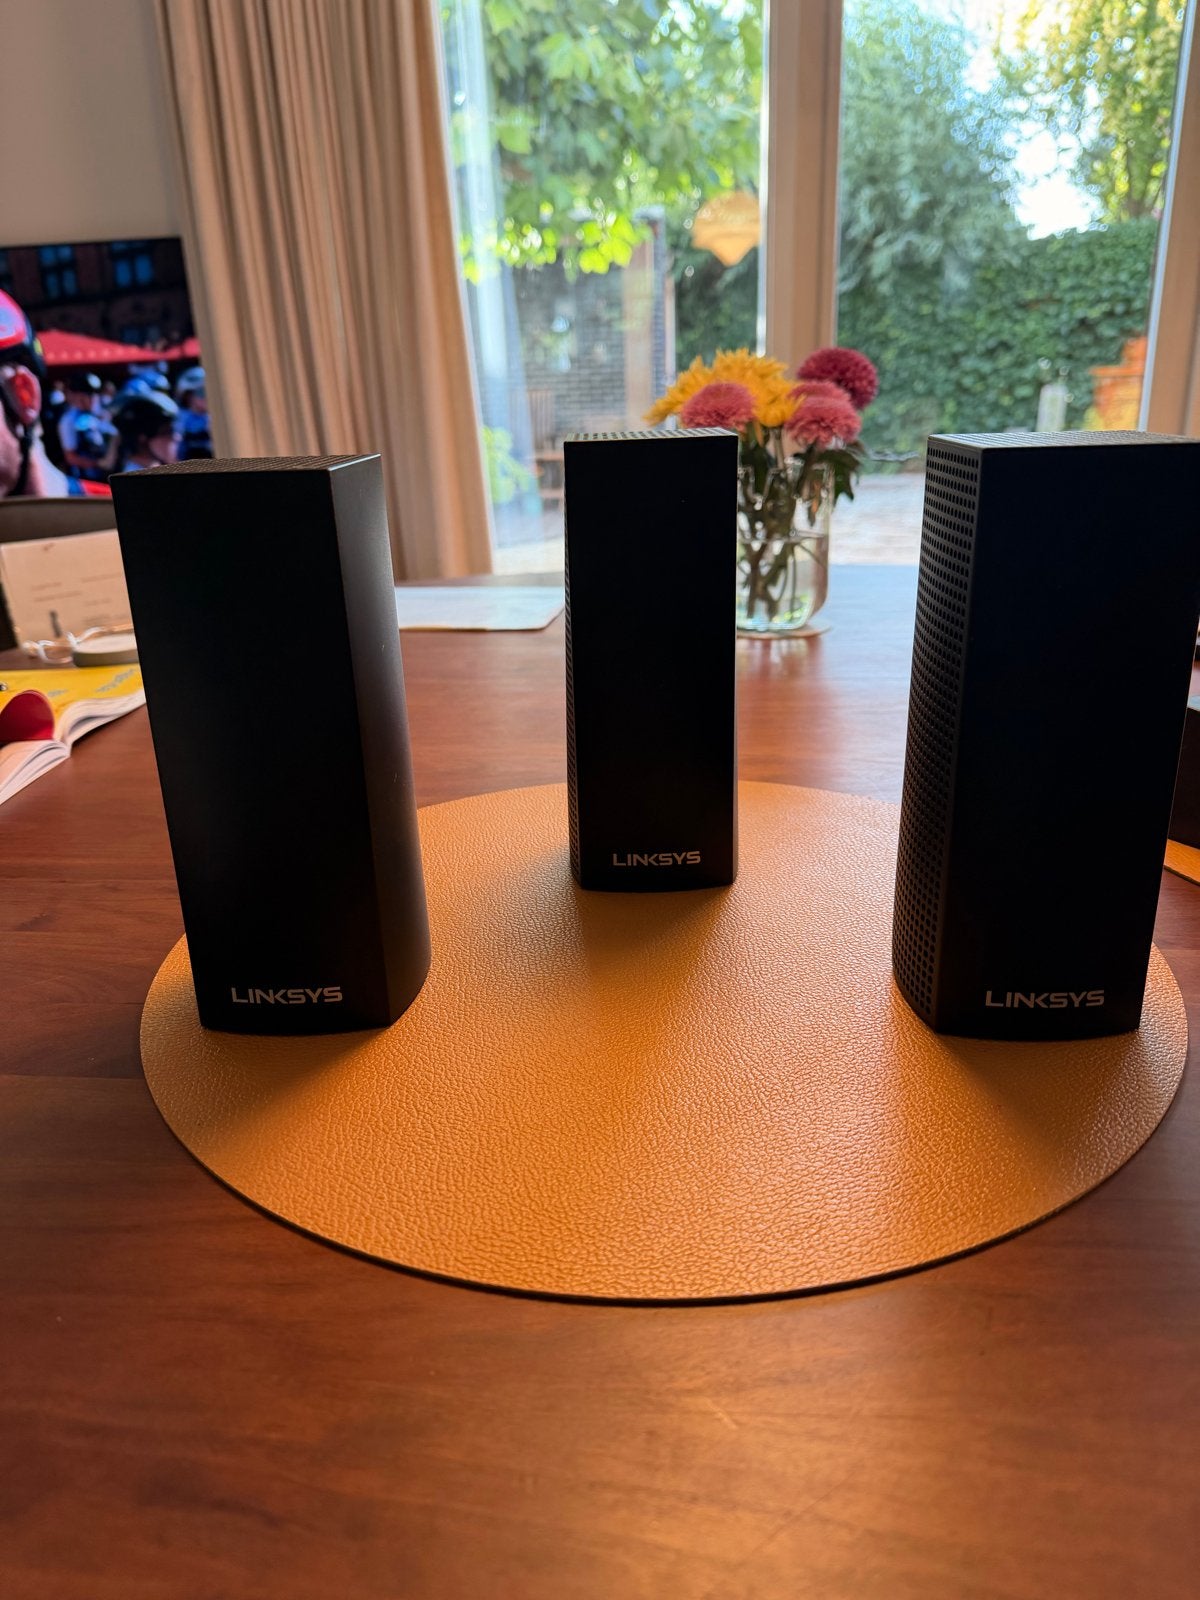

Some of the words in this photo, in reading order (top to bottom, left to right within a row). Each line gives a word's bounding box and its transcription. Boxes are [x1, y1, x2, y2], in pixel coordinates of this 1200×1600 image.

[612, 850, 702, 866] LINKSYS
[231, 985, 343, 1004] LINKSYS
[985, 989, 1105, 1008] LINKSYS
